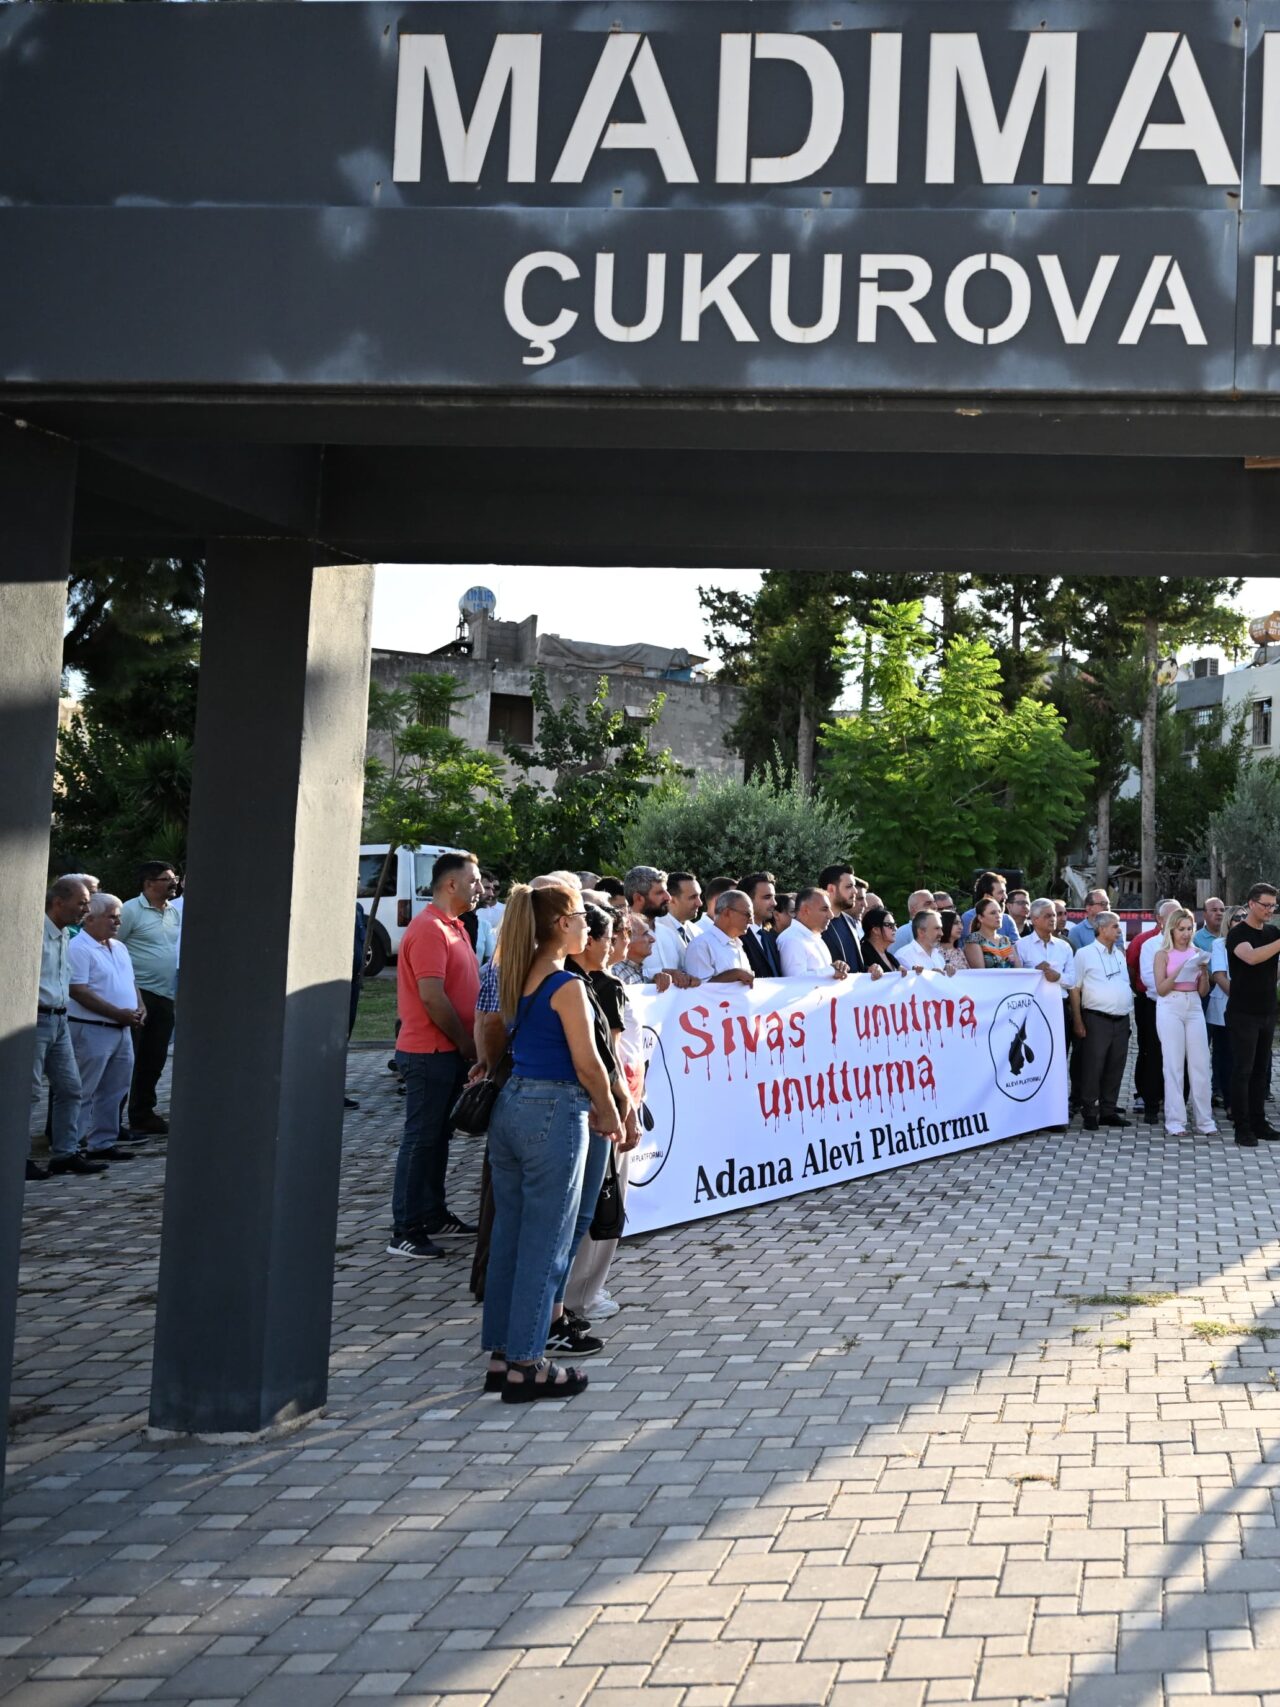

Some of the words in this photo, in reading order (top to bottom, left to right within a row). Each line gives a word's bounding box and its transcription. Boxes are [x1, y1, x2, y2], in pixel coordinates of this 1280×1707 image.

[503, 251, 1208, 366] ÇUKUROVA
[679, 1000, 806, 1070] Sivas
[853, 994, 978, 1048] unutma
[757, 1055, 937, 1123] unutturma
[694, 1158, 794, 1204] Adana
[801, 1131, 865, 1178] Alevi
[869, 1111, 990, 1160] Platformu
